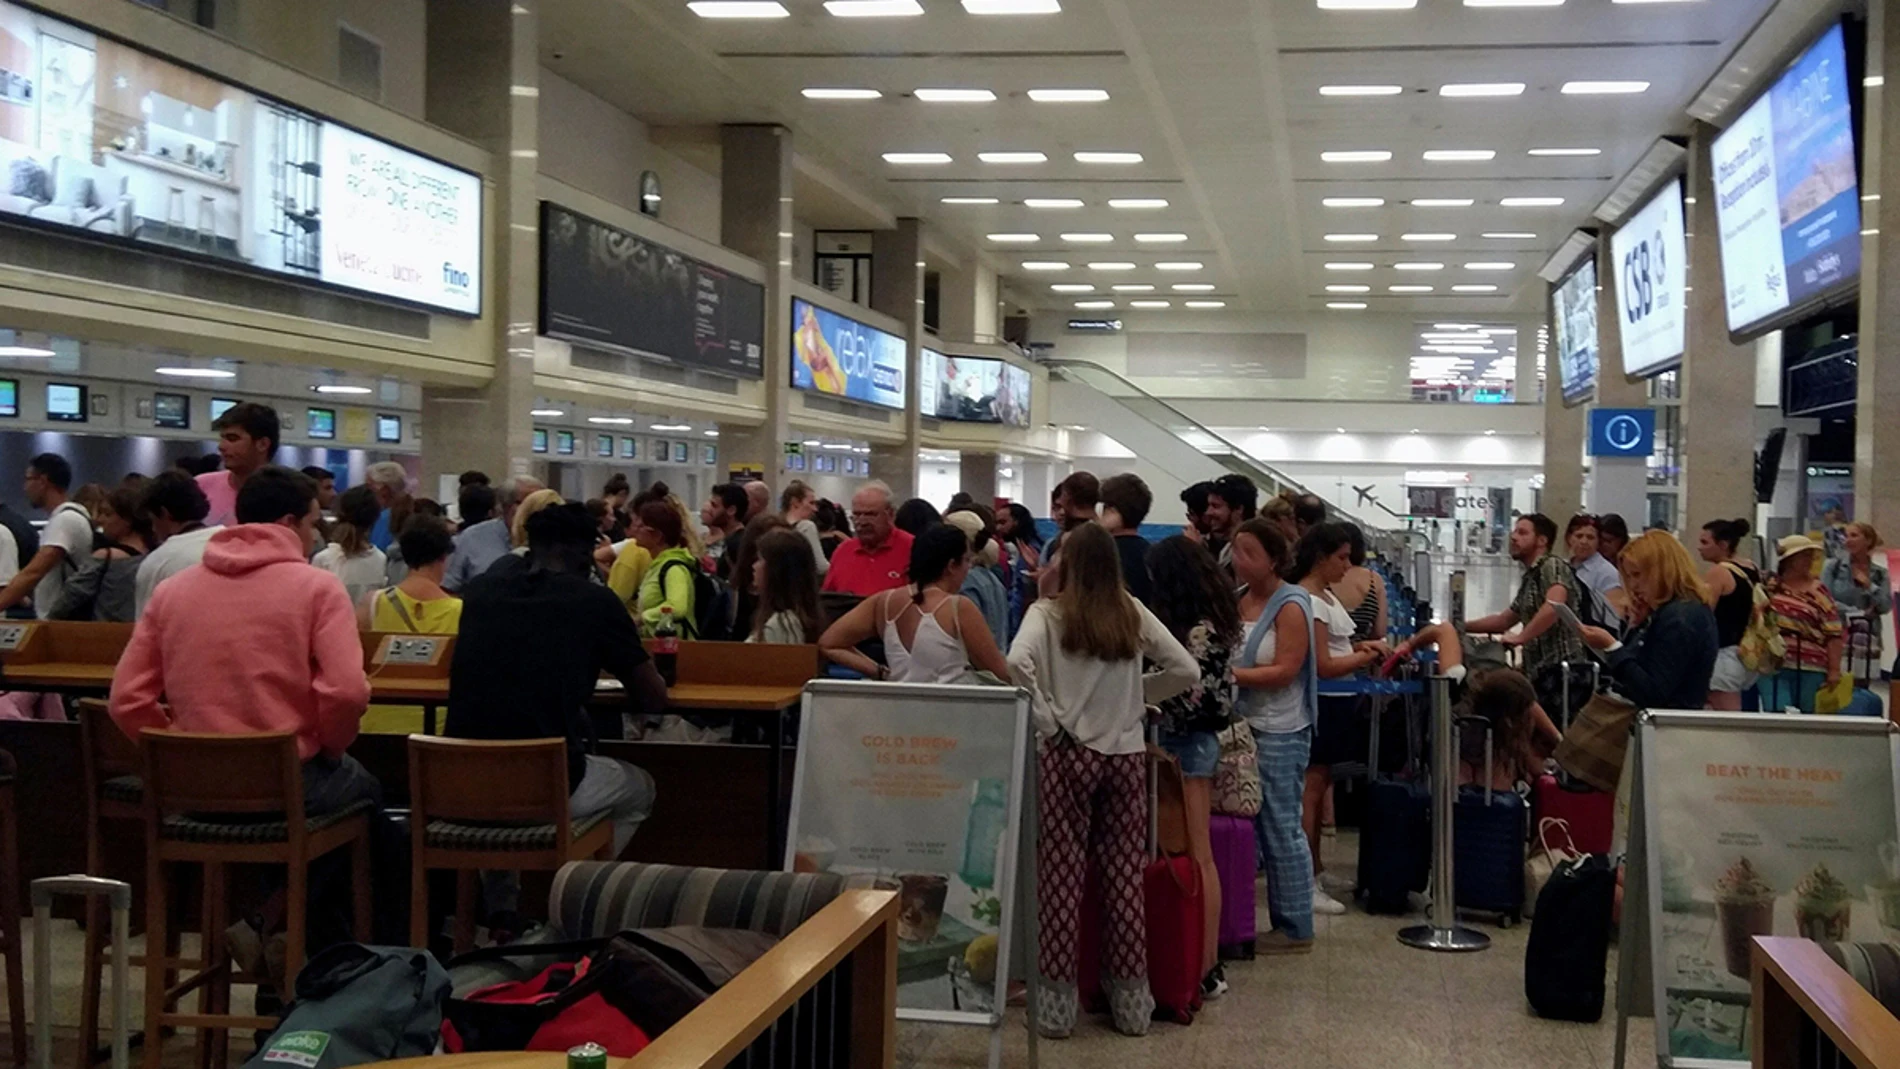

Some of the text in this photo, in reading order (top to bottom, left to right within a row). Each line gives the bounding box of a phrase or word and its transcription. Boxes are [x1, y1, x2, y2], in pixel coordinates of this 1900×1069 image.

[443, 261, 470, 288] fino
[1624, 240, 1653, 324] CSB
[836, 321, 875, 379] relax
[1440, 496, 1498, 513] gates
[862, 735, 958, 750] COLD BREW
[876, 752, 939, 765] IS BACK
[1705, 763, 1844, 782] BEAT THE HEAT
